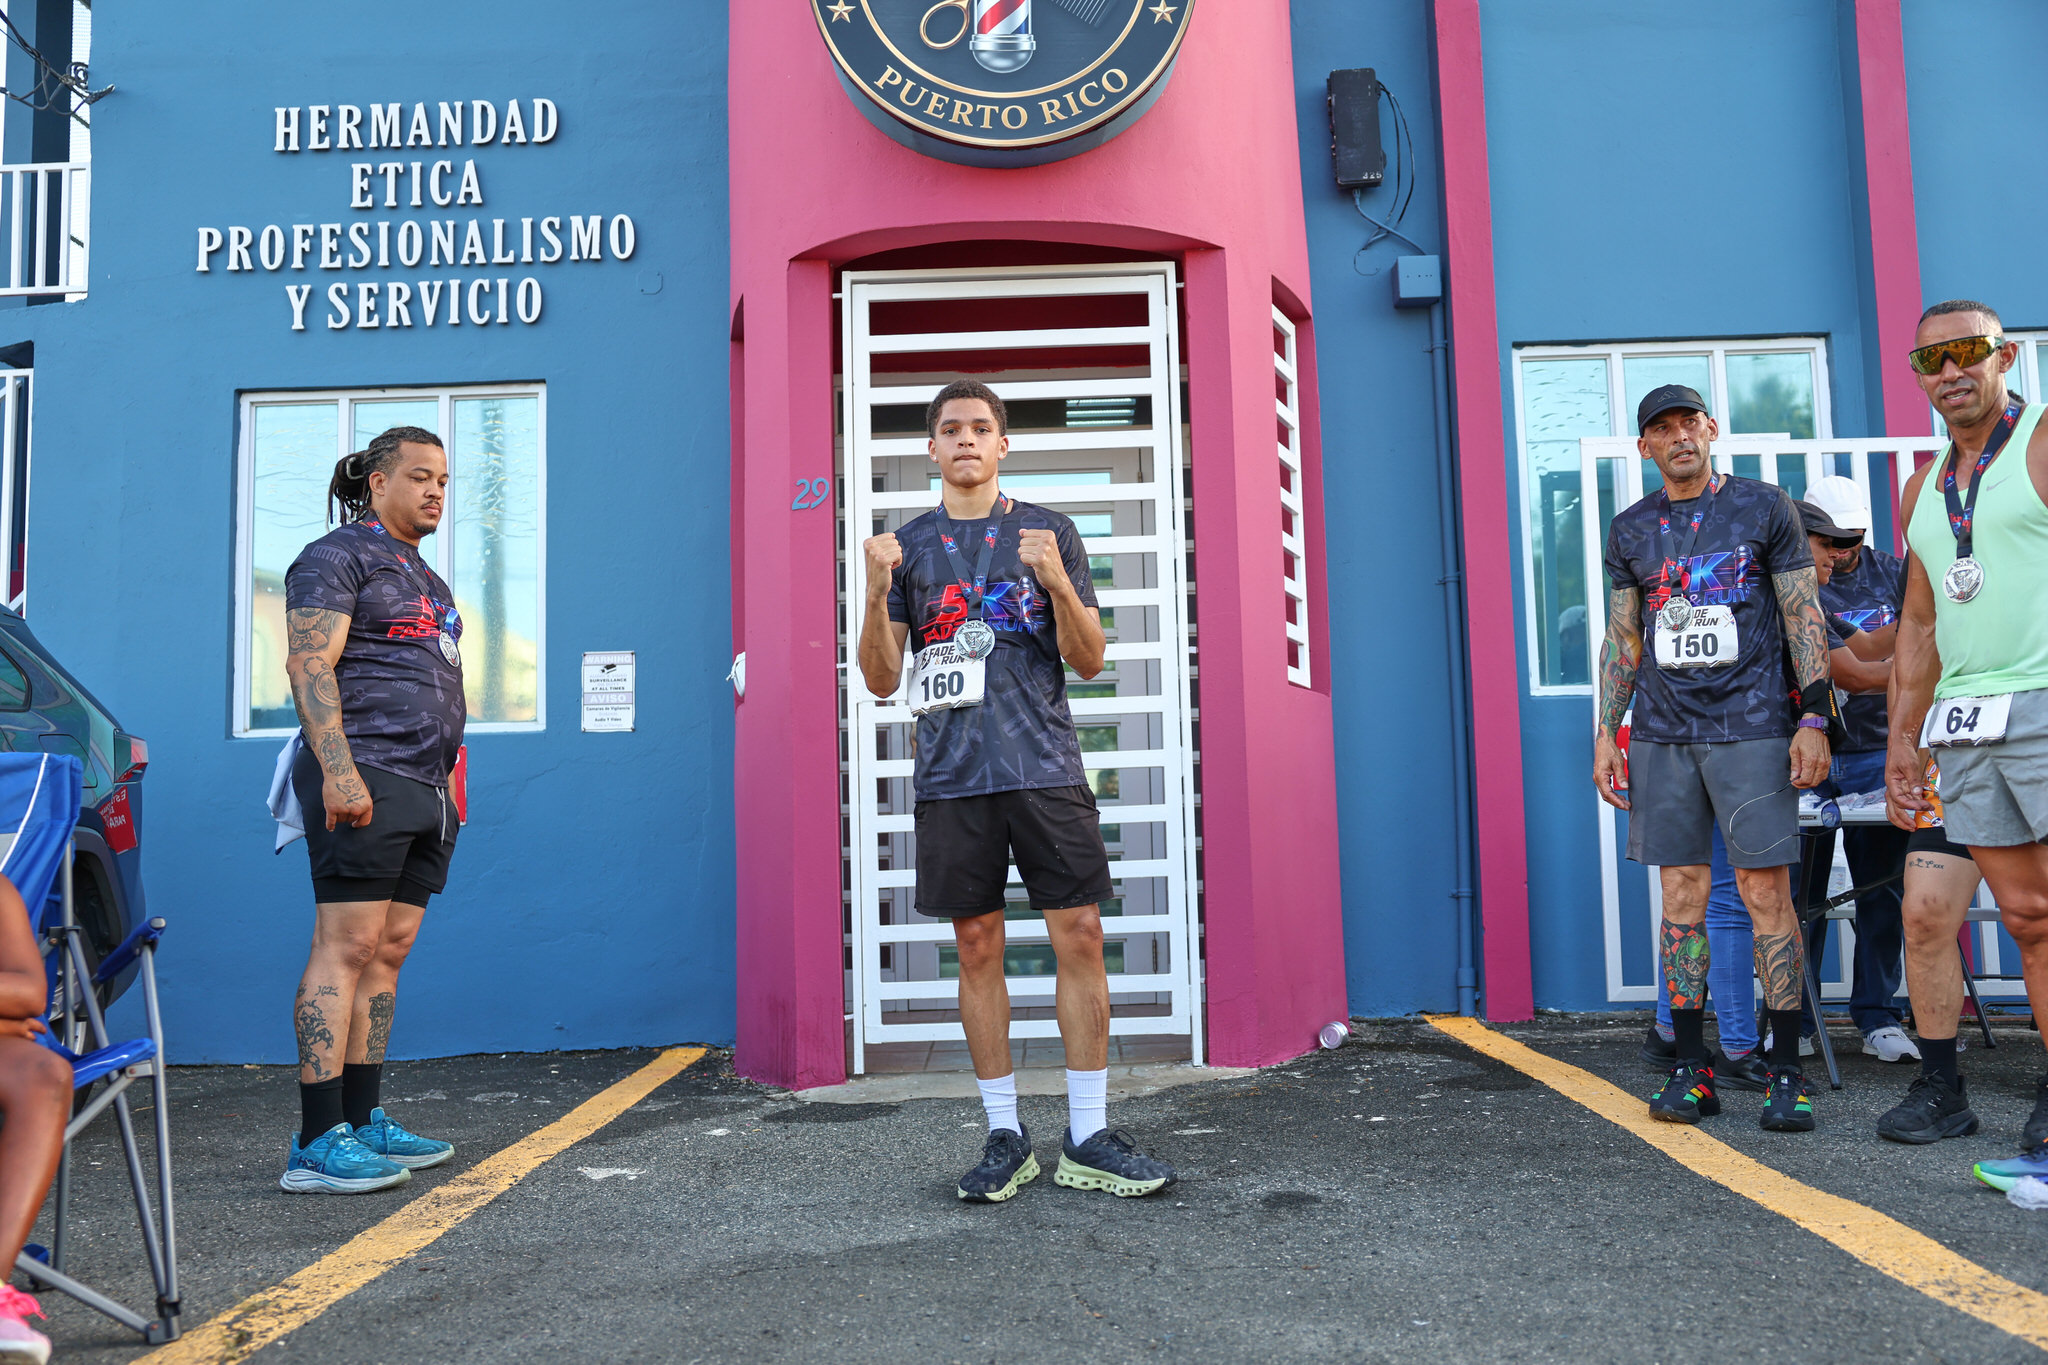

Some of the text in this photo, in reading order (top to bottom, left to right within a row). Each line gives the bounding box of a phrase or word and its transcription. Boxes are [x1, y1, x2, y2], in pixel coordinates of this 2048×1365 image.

[873, 64, 1129, 130] PUERTO RICO
[273, 97, 560, 152] HERMANDAD
[350, 159, 484, 209] ETICA
[196, 213, 637, 273] PROFESIONALISMO
[285, 276, 543, 331] Y SERVICIO
[791, 477, 830, 511] 29
[1704, 589, 1746, 606] RUN
[1694, 617, 1719, 627] RUN
[930, 645, 956, 659] FADE
[941, 654, 965, 665] RUN
[1672, 633, 1719, 658] 150
[585, 656, 630, 664] WARNING
[590, 694, 626, 703] AVISO
[921, 671, 965, 702] 160
[1946, 706, 1982, 734] 64
